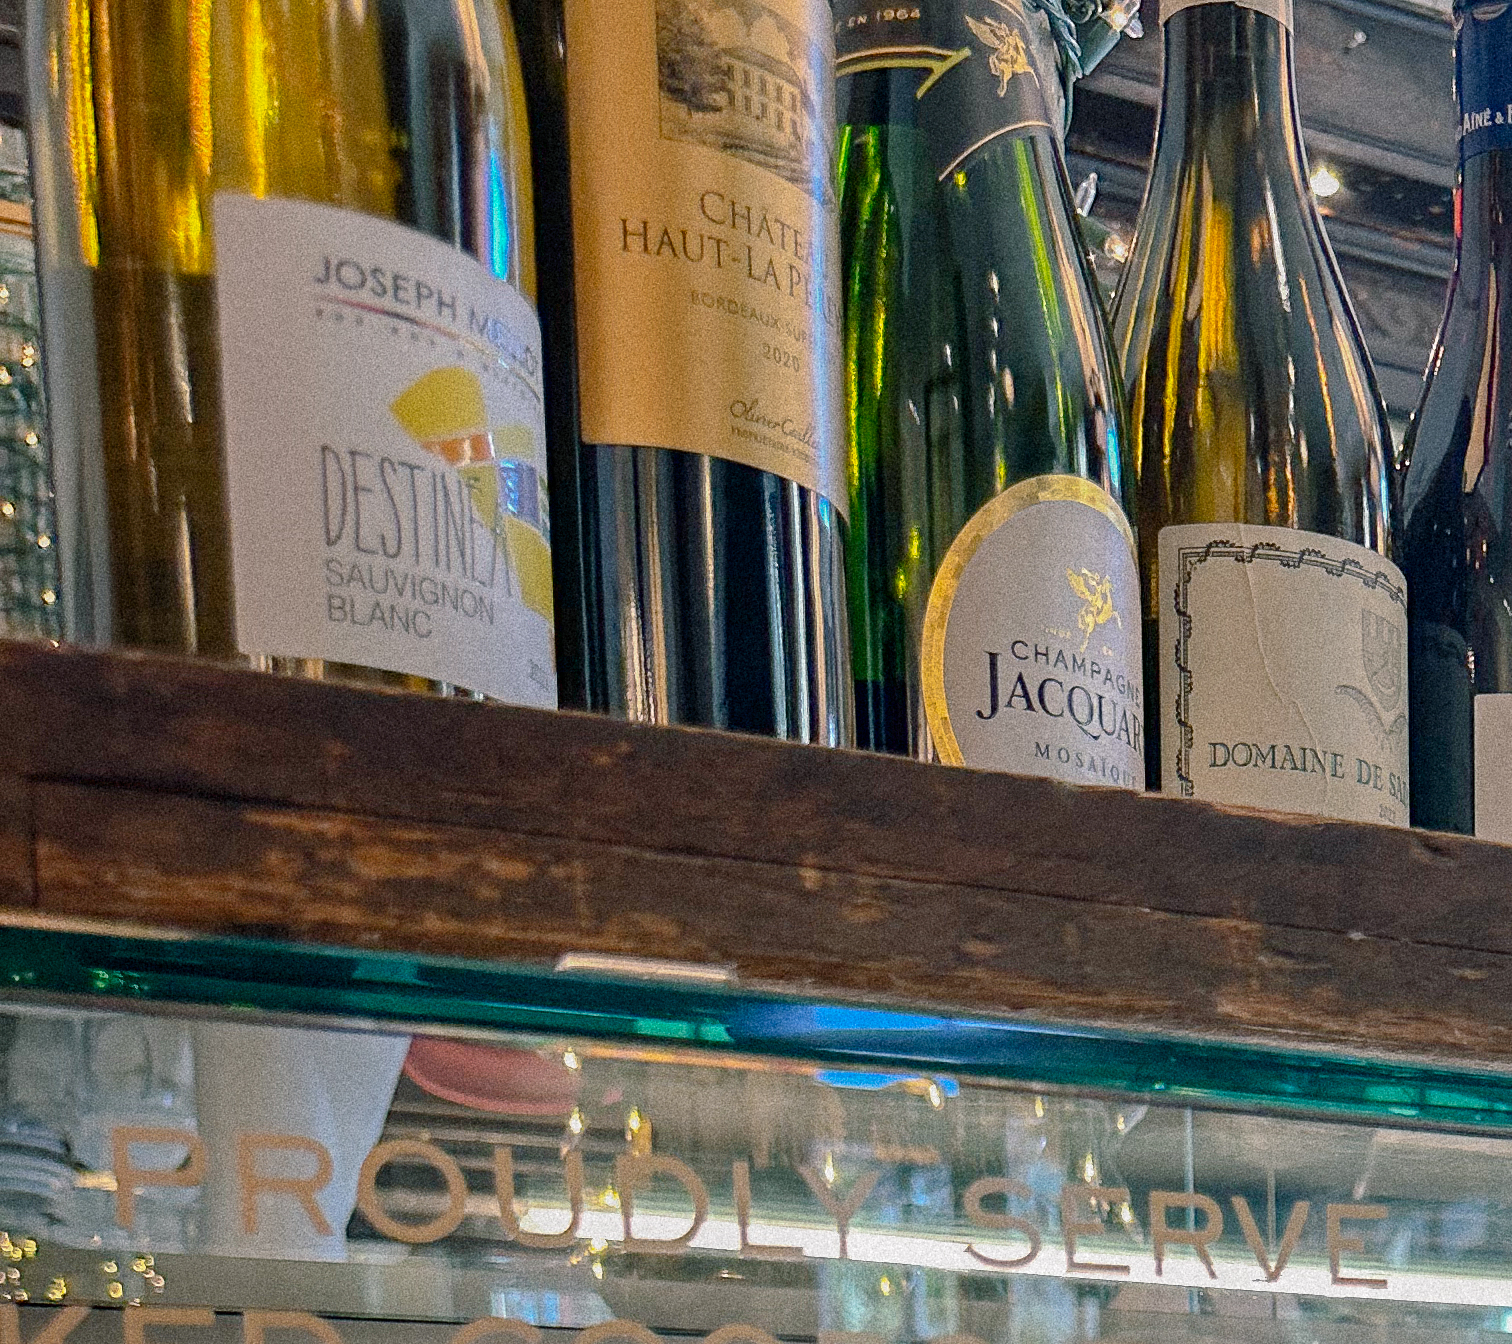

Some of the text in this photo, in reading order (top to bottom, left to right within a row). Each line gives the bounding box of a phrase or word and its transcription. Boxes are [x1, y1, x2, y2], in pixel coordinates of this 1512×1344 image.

[313, 256, 457, 321] JOSEPH
[689, 289, 779, 331] BORDEAUX
[762, 342, 801, 373] 2020
[326, 557, 495, 626] SAUVIGNON
[327, 593, 433, 640] BLANC
[1208, 741, 1346, 780] DOMAINE
[1356, 758, 1383, 791] DE
[111, 1126, 1388, 1289] PROUDLY SERVE
